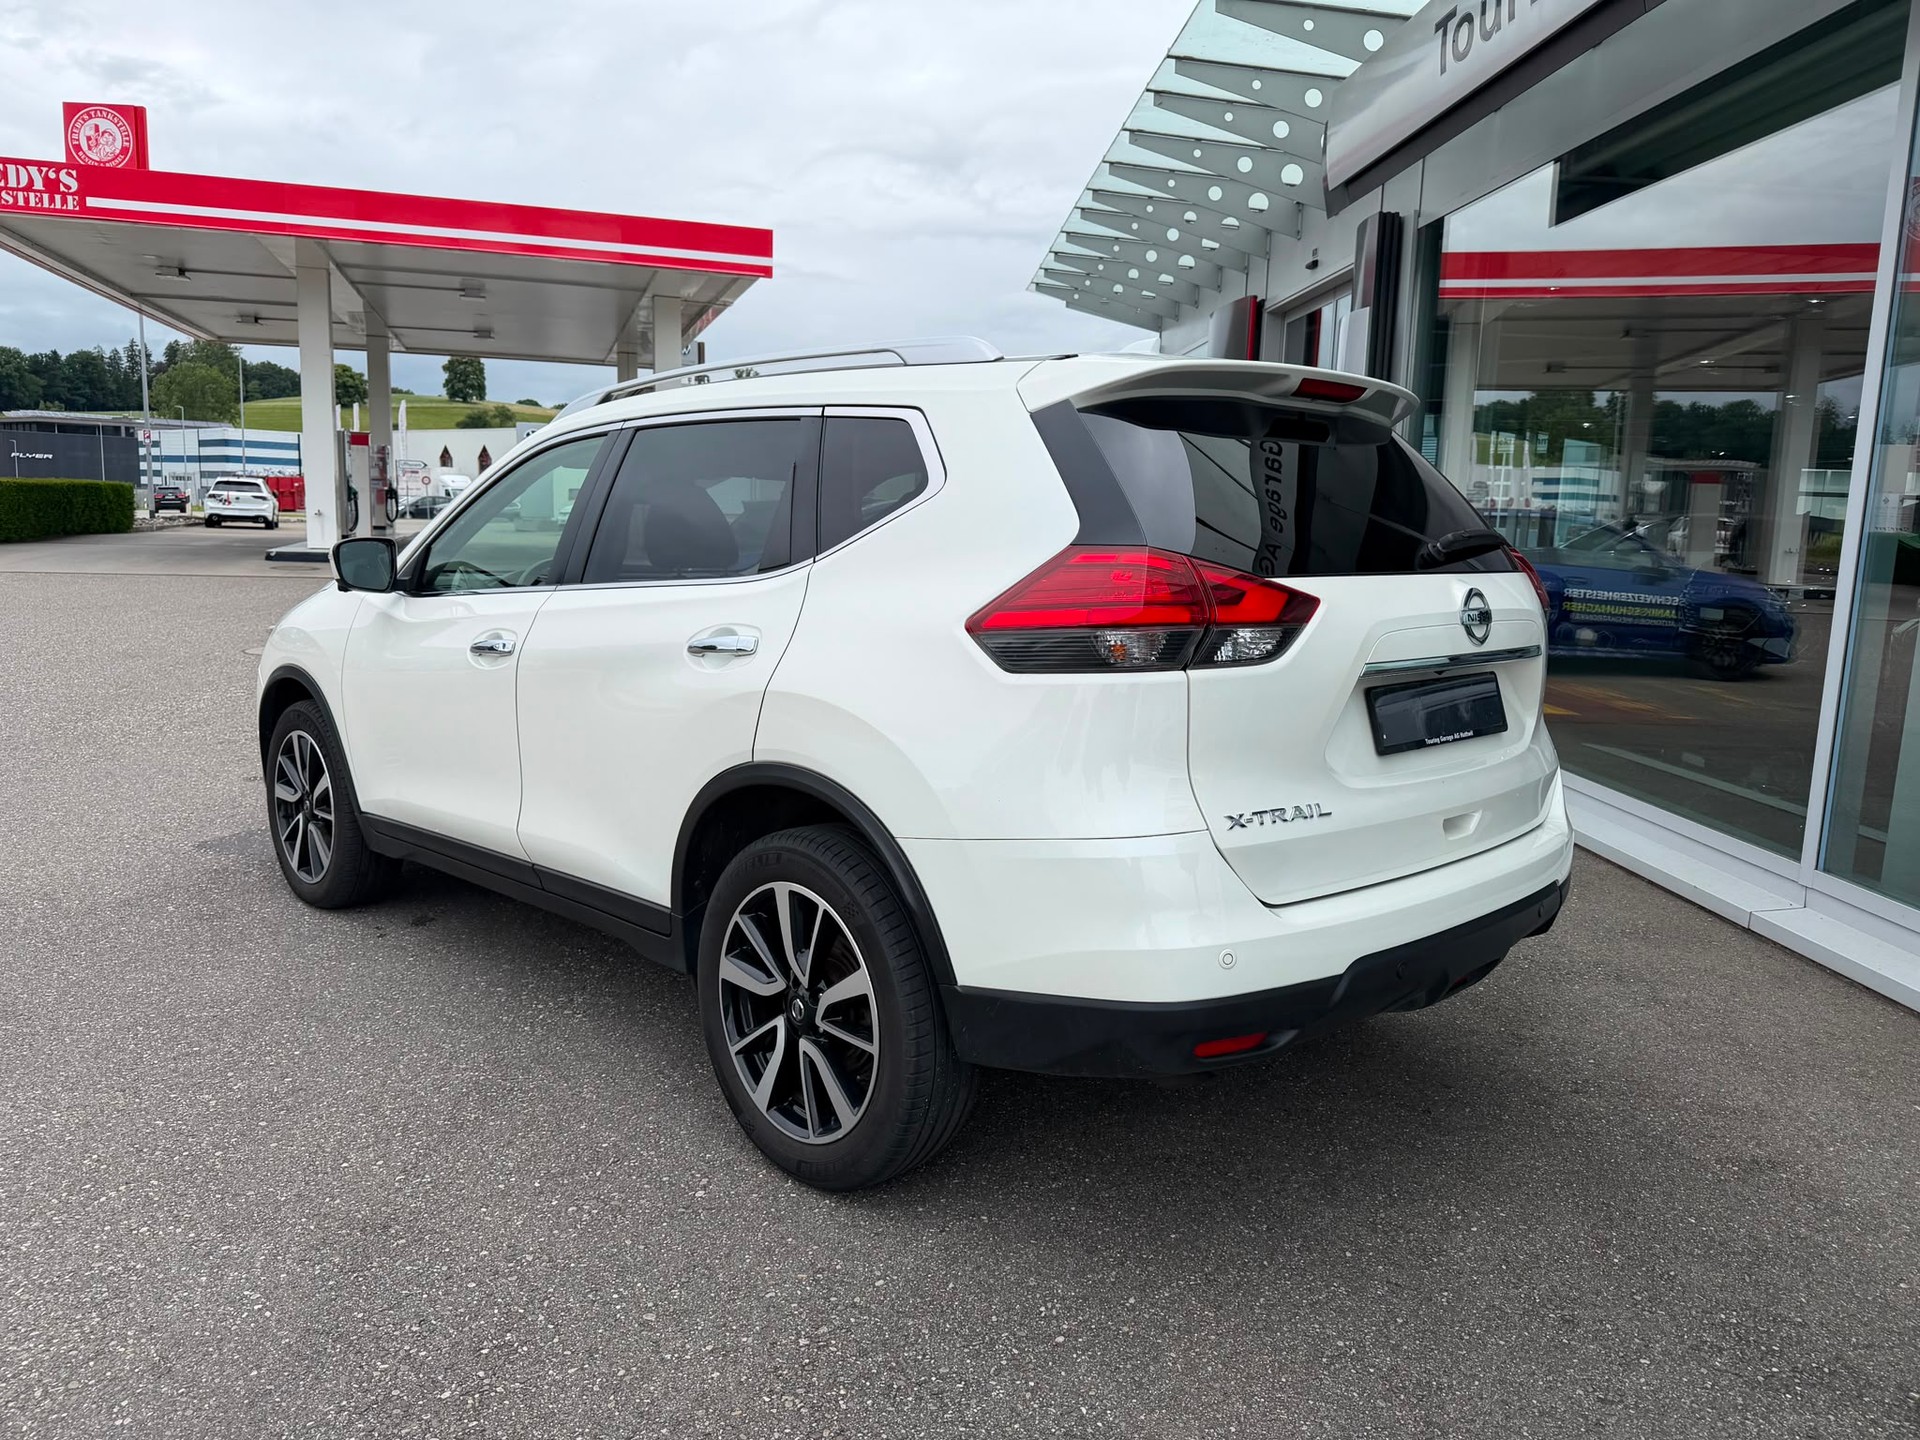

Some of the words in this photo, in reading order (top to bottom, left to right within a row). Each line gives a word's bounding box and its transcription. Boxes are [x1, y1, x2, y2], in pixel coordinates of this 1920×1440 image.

[89, 110, 130, 148] TANKSTELLE
[10, 452, 53, 460] FLYER
[1223, 802, 1332, 831] X-TRAIL
